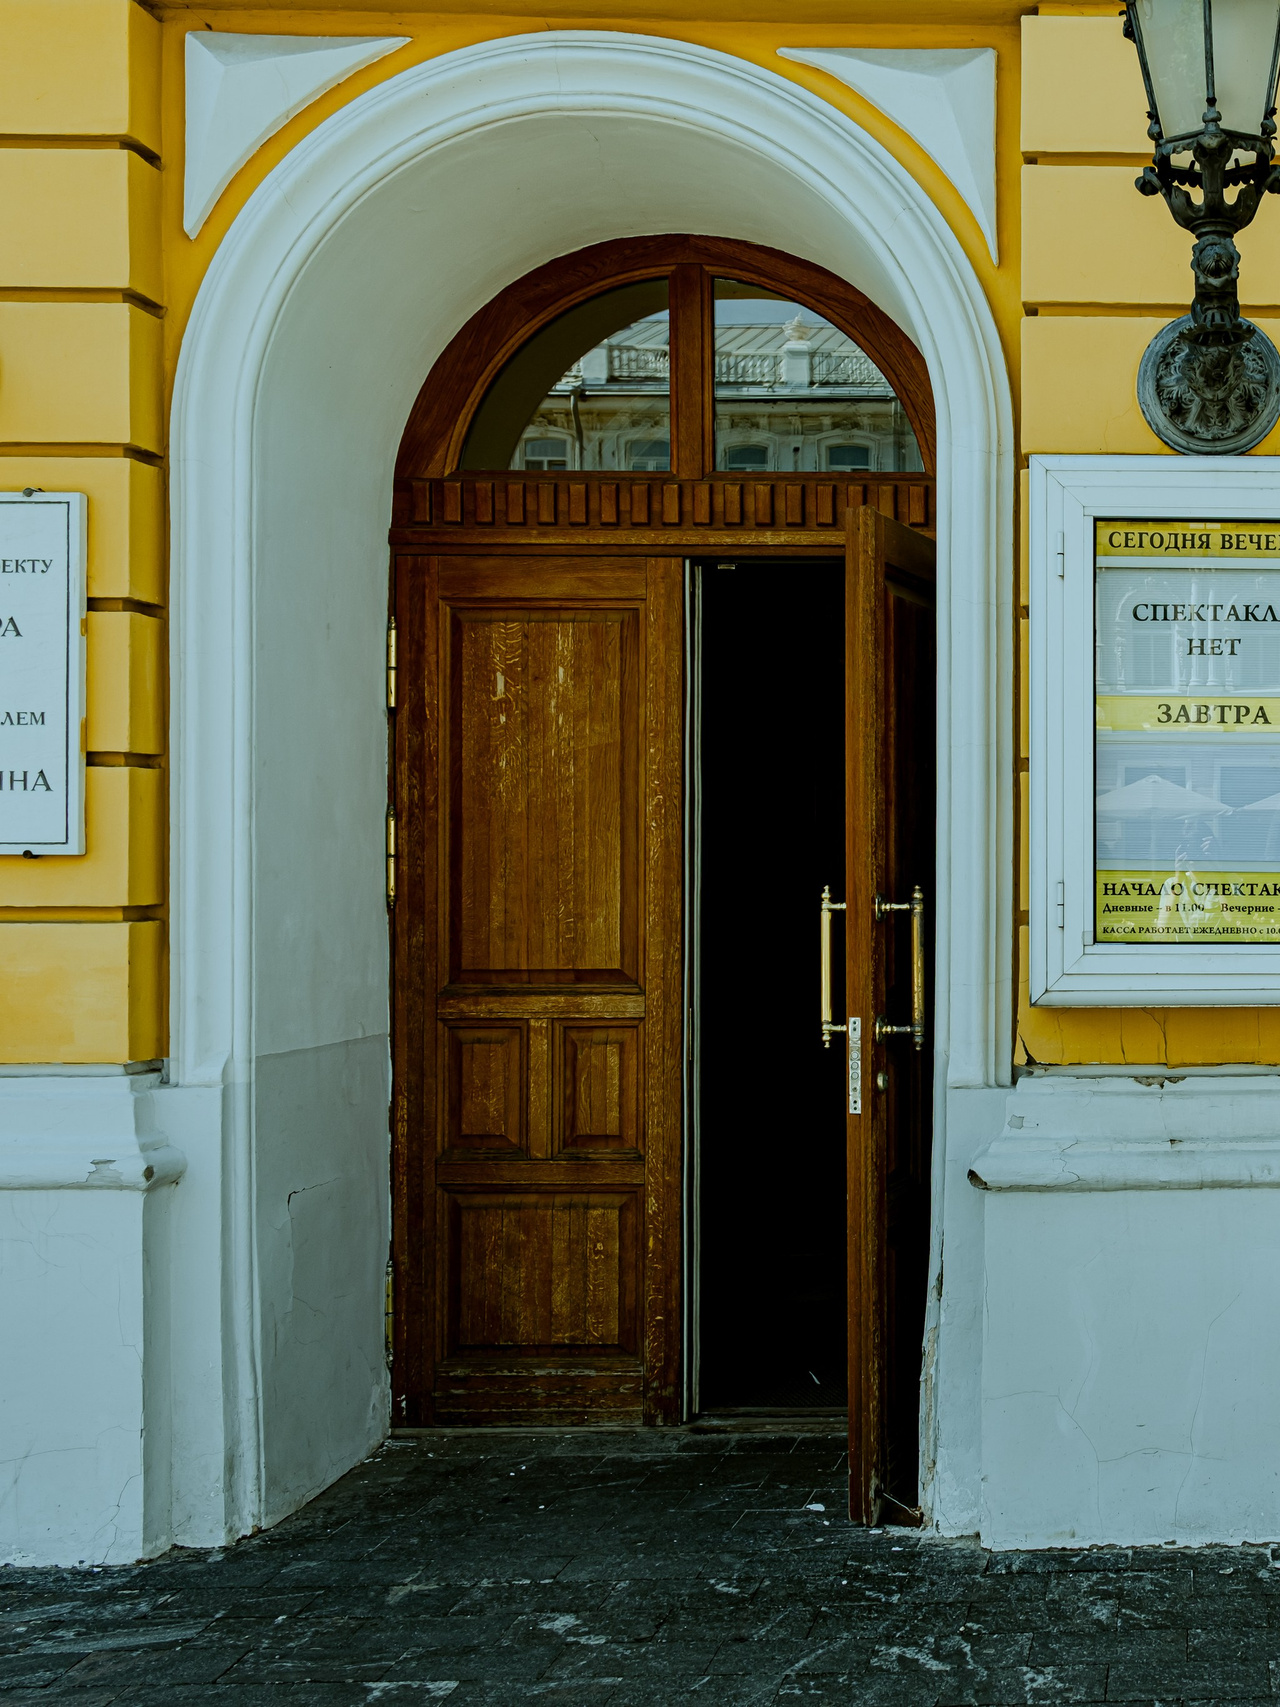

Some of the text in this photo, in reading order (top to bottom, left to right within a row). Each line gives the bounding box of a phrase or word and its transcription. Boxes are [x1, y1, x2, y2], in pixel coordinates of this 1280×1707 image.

[1109, 531, 1211, 552] СЕГОДНЯ
[0, 559, 53, 574] ЕКТУ
[1187, 638, 1241, 656] НЕТ
[1157, 703, 1272, 725] ЗАВТРА
[1103, 882, 1184, 897] НАЧАЛО
[1103, 903, 1153, 914] Дневные
[1175, 903, 1205, 912] 11.00
[1220, 904, 1274, 915] Вечерние
[1102, 926, 1136, 934] КАССА
[1138, 926, 1191, 935] РАБОТАЕТ
[1193, 926, 1257, 936] ЕЖЕДНЕВНО
